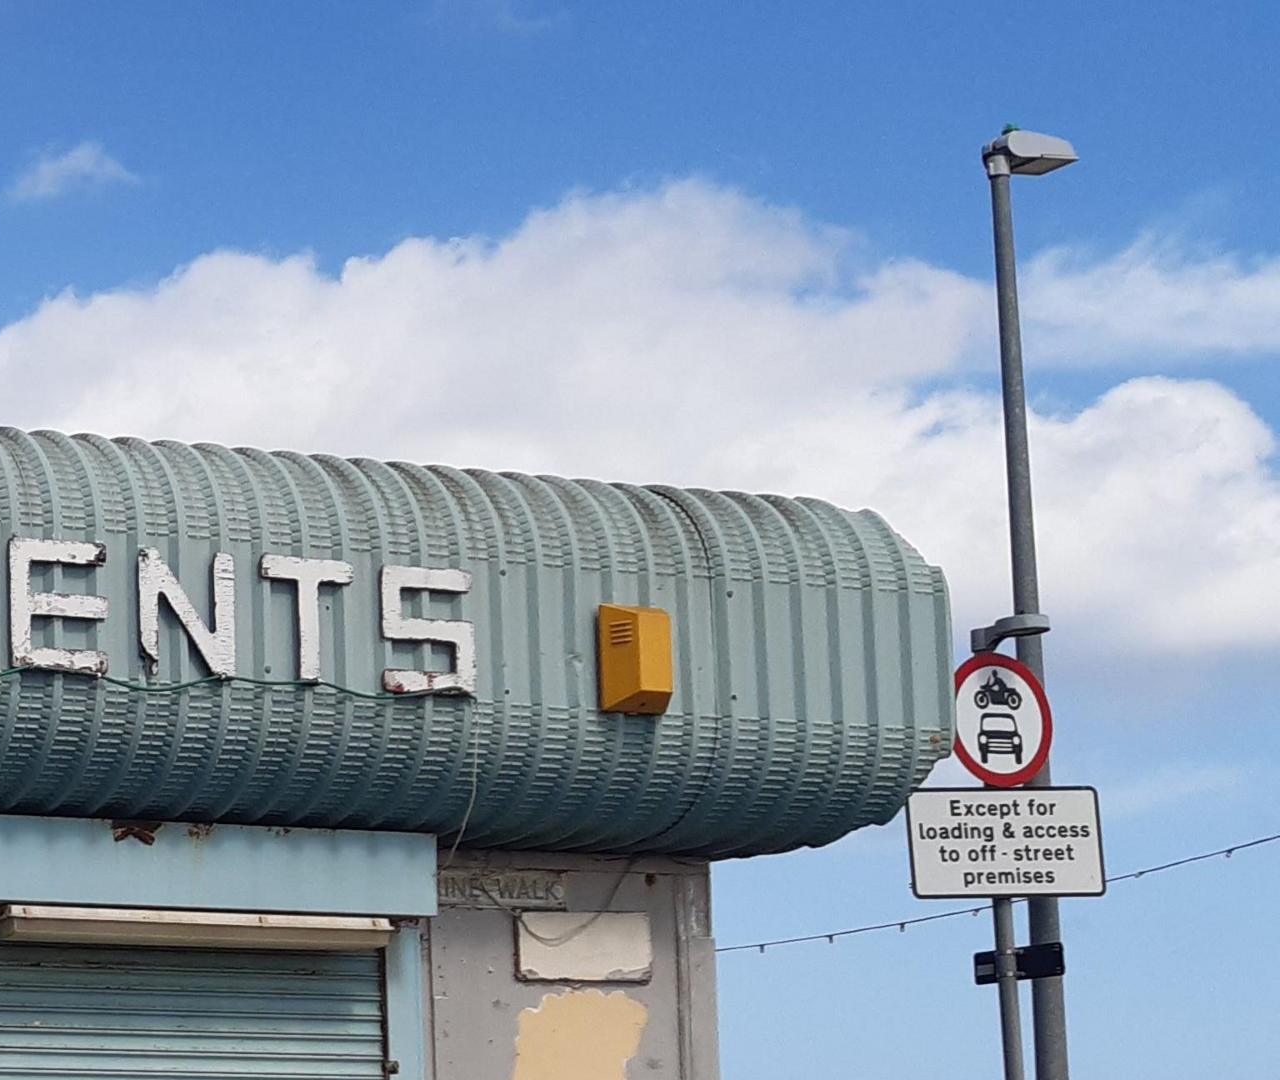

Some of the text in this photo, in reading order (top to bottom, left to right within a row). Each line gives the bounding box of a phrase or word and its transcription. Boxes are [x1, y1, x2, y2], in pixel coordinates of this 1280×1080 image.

[950, 799, 1057, 820] Except for
[919, 823, 1091, 842] loading & access
[939, 846, 960, 862] to
[963, 868, 1056, 888] premises
[497, 878, 561, 900] WALK
